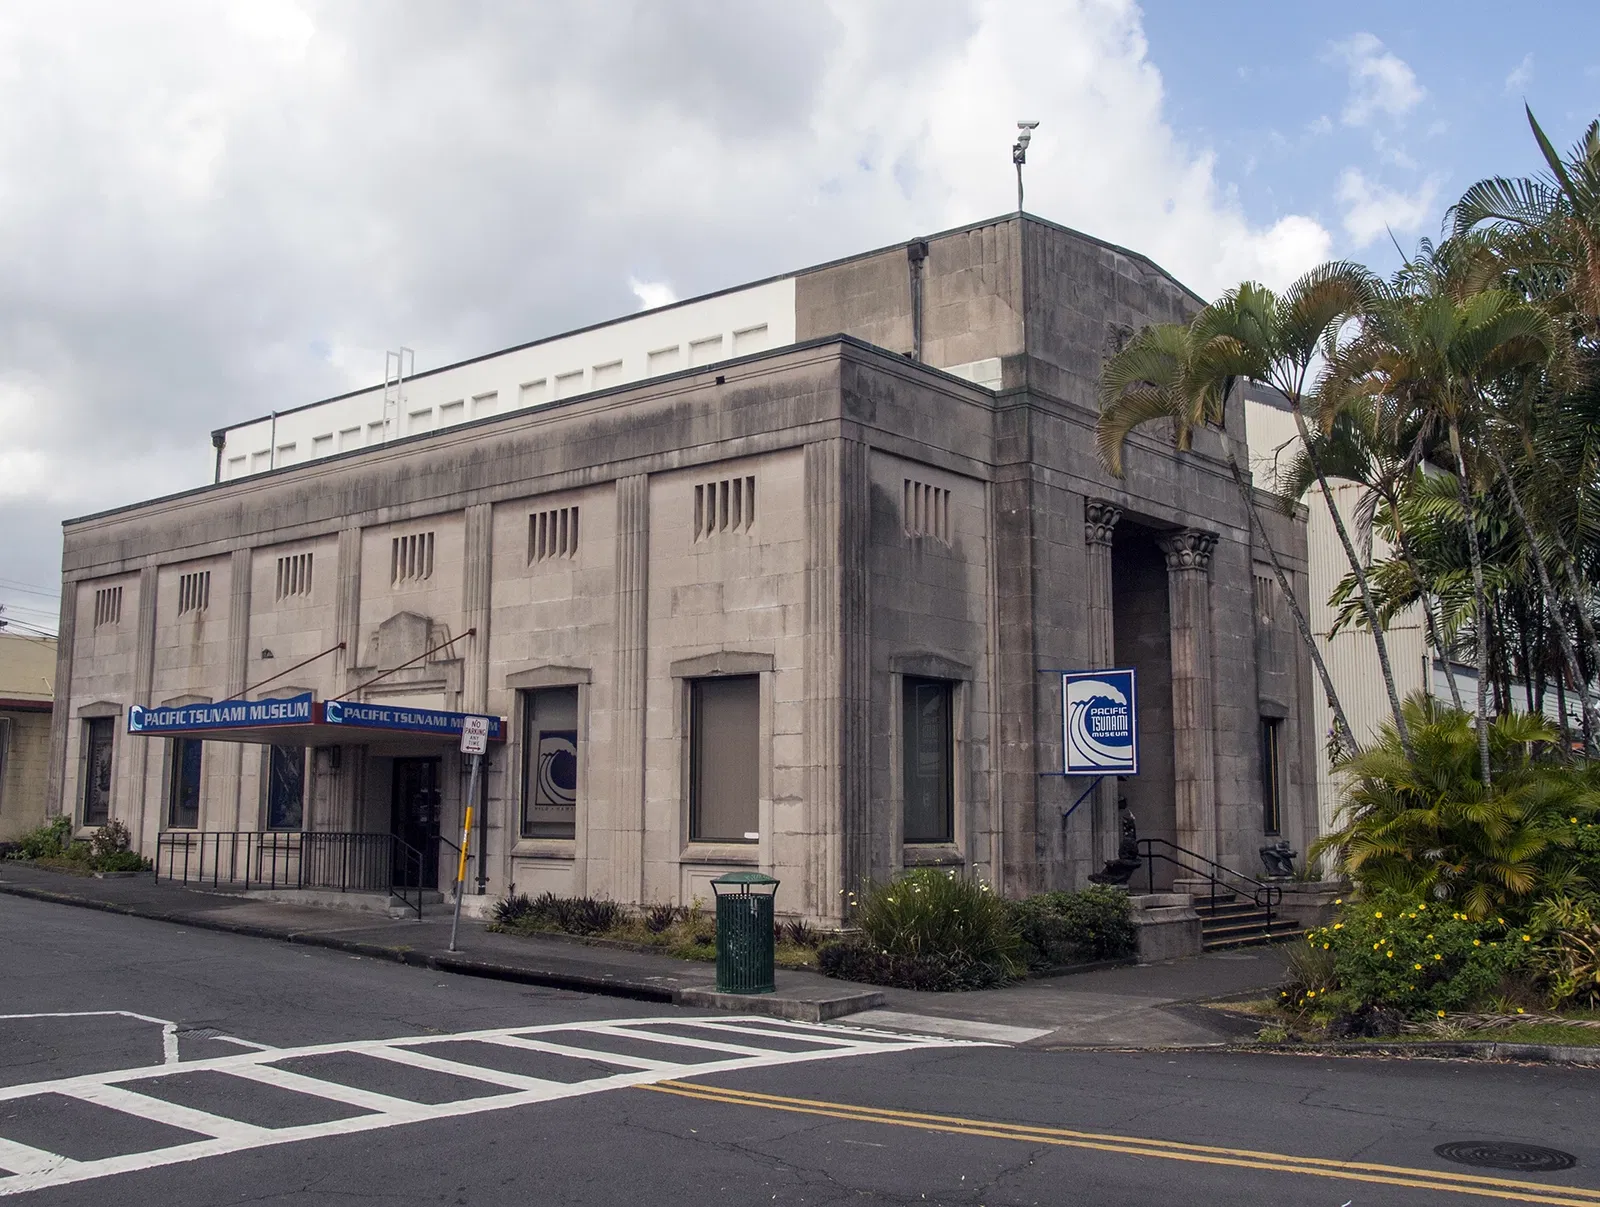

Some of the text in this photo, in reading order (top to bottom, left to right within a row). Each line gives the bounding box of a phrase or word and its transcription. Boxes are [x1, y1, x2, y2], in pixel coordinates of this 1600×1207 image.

[144, 702, 309, 726] PACIFIC TSUNAMI MUSEUM
[344, 707, 391, 722] PACIFIC
[393, 712, 448, 727] TSUNAMI
[1090, 707, 1128, 715] PACIFIC
[471, 720, 481, 728] NO
[1091, 715, 1128, 731] TSUNAMI
[465, 727, 486, 736] PARKING
